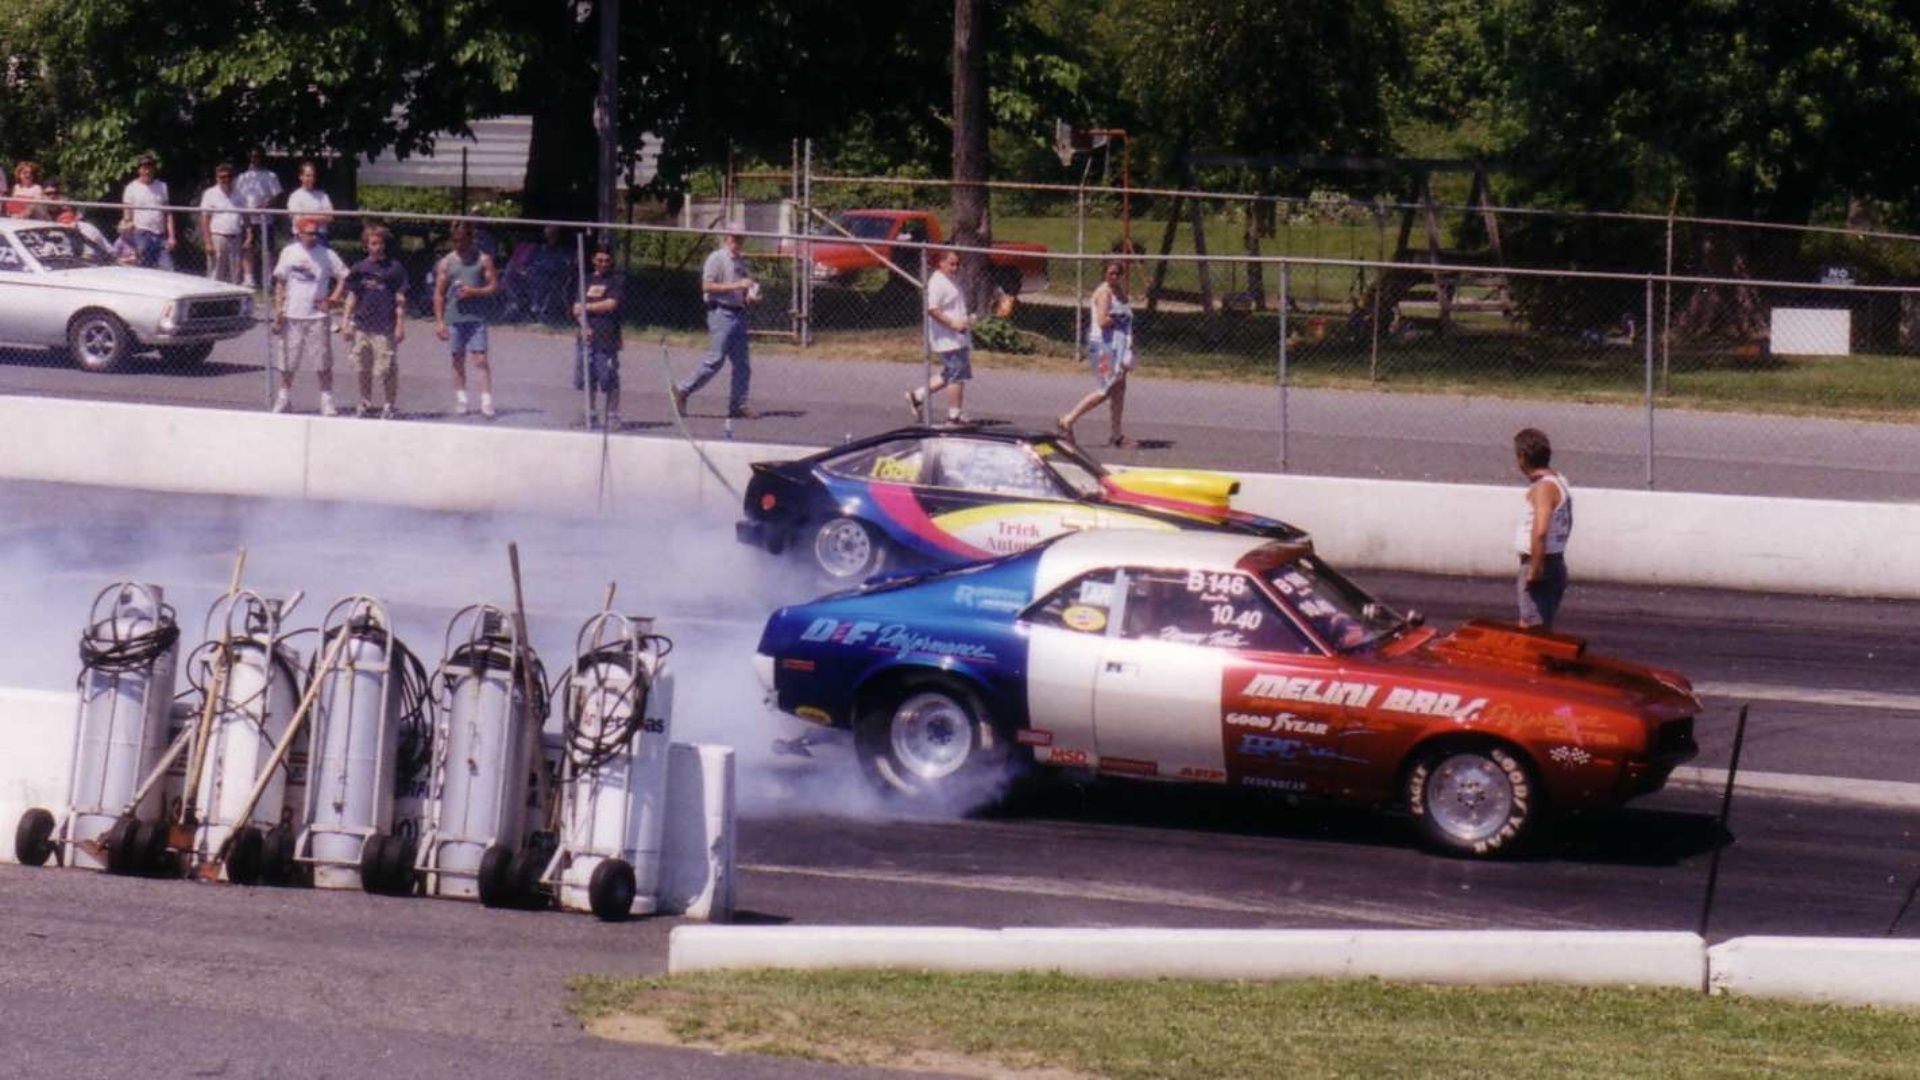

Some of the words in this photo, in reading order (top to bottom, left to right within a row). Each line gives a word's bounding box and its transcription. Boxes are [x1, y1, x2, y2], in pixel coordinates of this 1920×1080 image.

[998, 521, 1040, 538] Trick
[1187, 571, 1205, 592] B
[1208, 573, 1245, 595] 146
[1211, 604, 1263, 630] 10.40
[875, 624, 996, 660] Performance
[1242, 673, 1379, 709] MELINI
[1048, 749, 1088, 765] MSD
